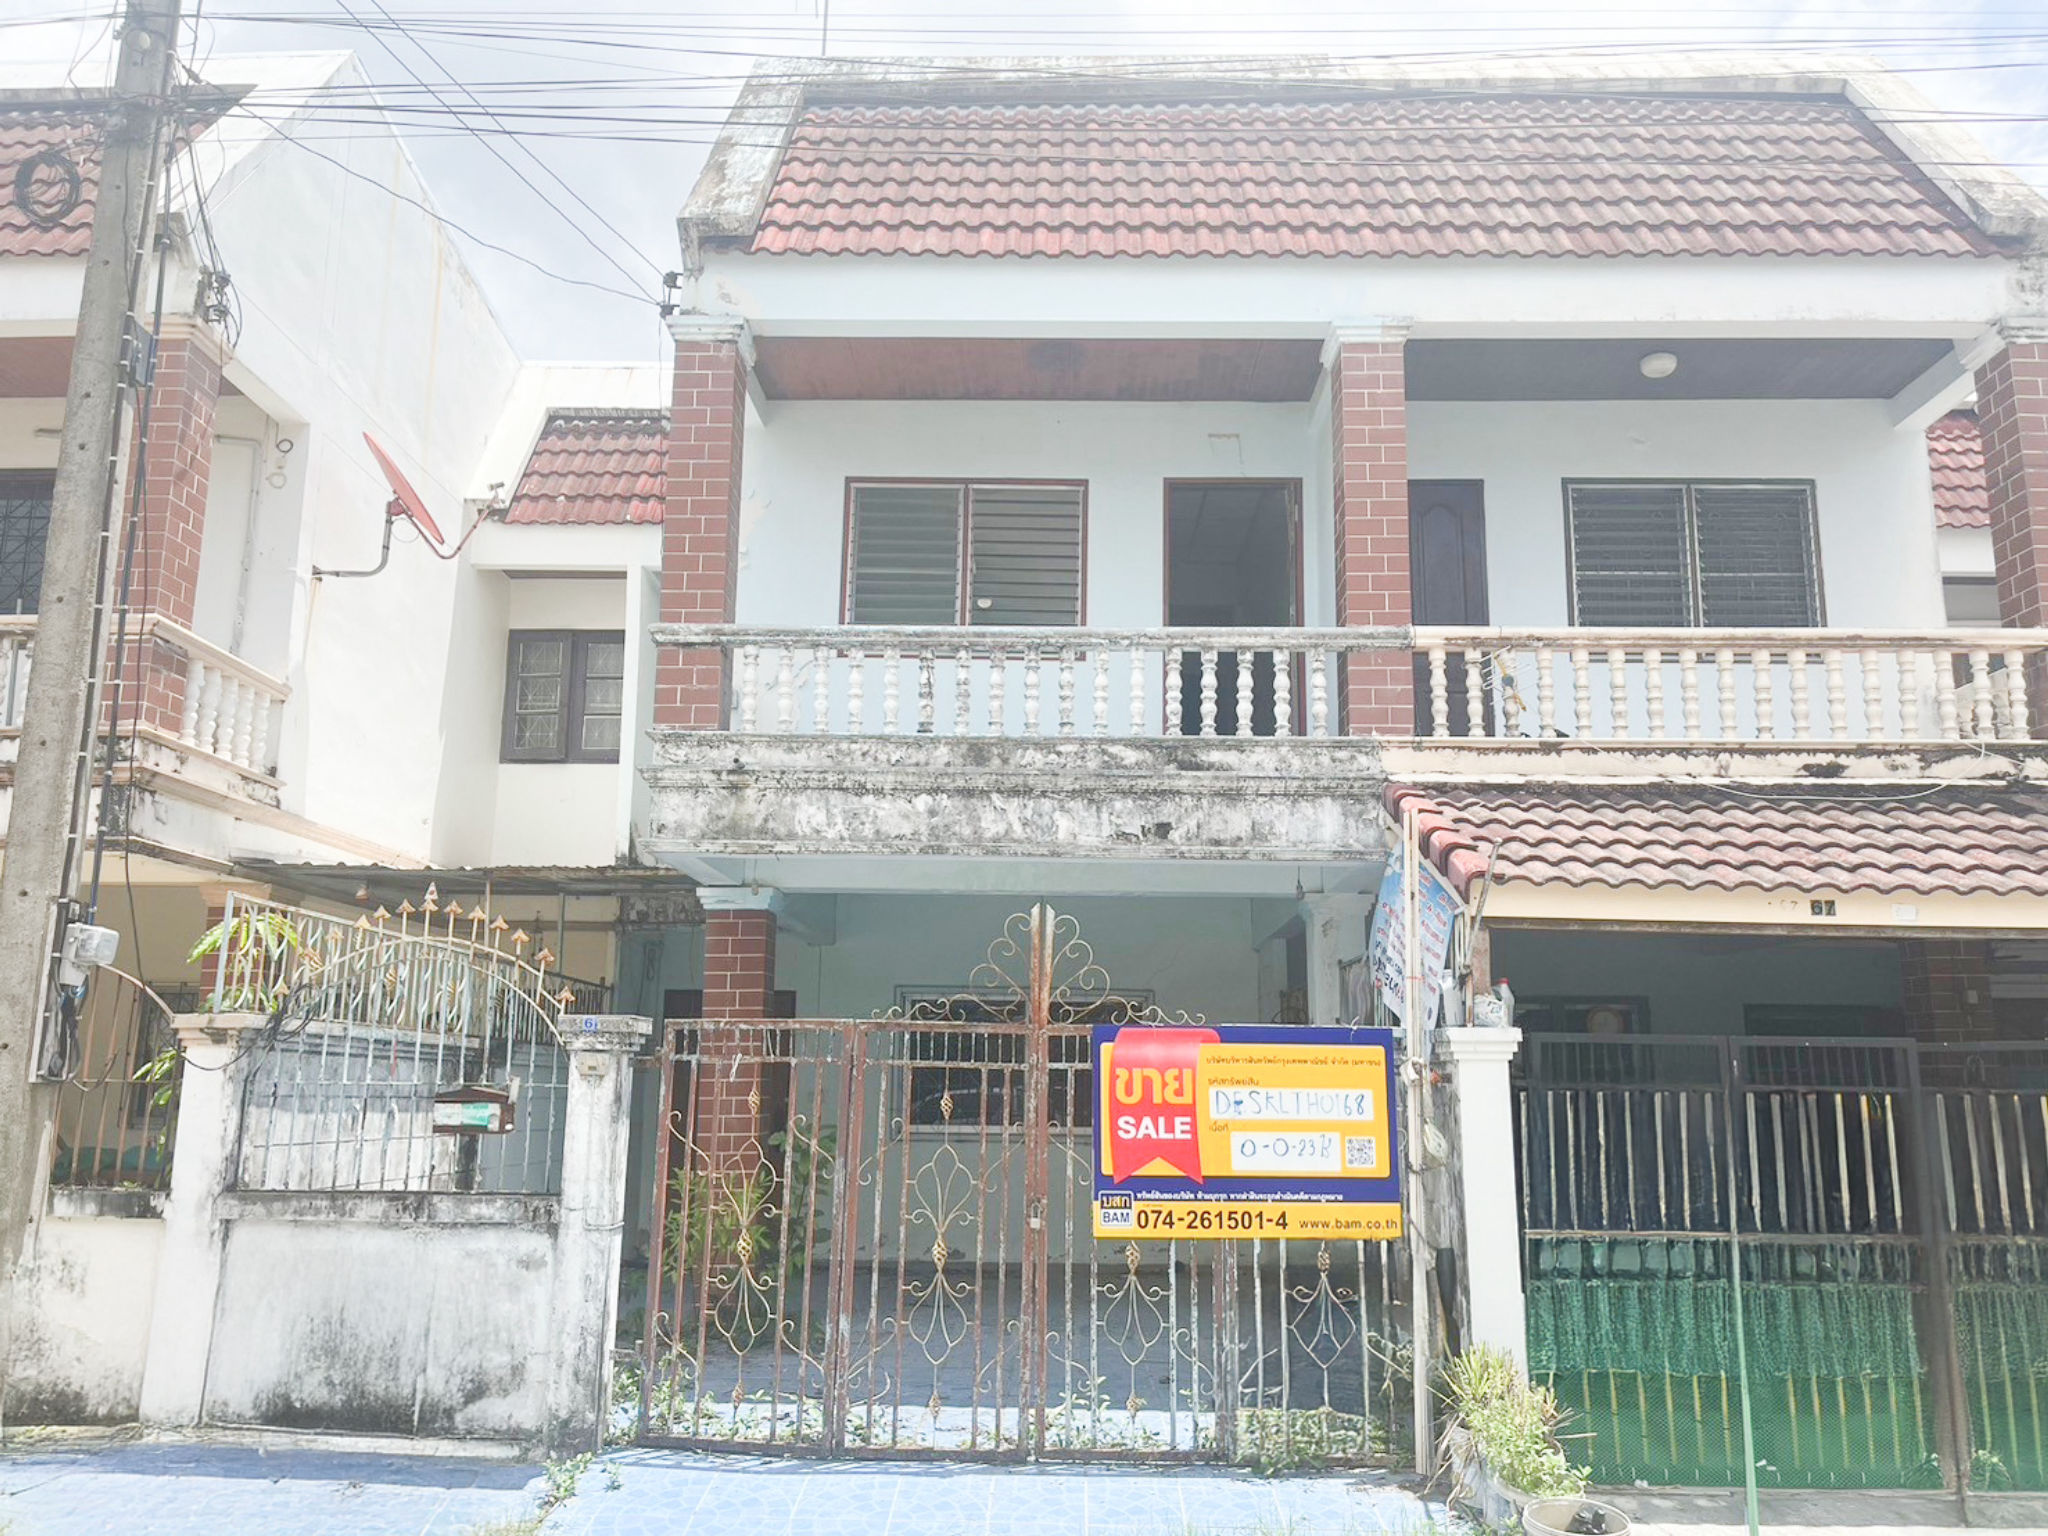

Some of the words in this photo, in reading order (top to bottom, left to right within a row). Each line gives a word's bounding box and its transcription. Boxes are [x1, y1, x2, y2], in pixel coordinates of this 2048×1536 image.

[1810, 900, 1836, 915] 67
[1115, 1068, 1192, 1105] ขาย
[1117, 1116, 1192, 1140] SALE
[1103, 1211, 1130, 1223] BAM
[1137, 1209, 1288, 1230] 074-261501-4
[1299, 1218, 1398, 1230] www.bam.co.th
